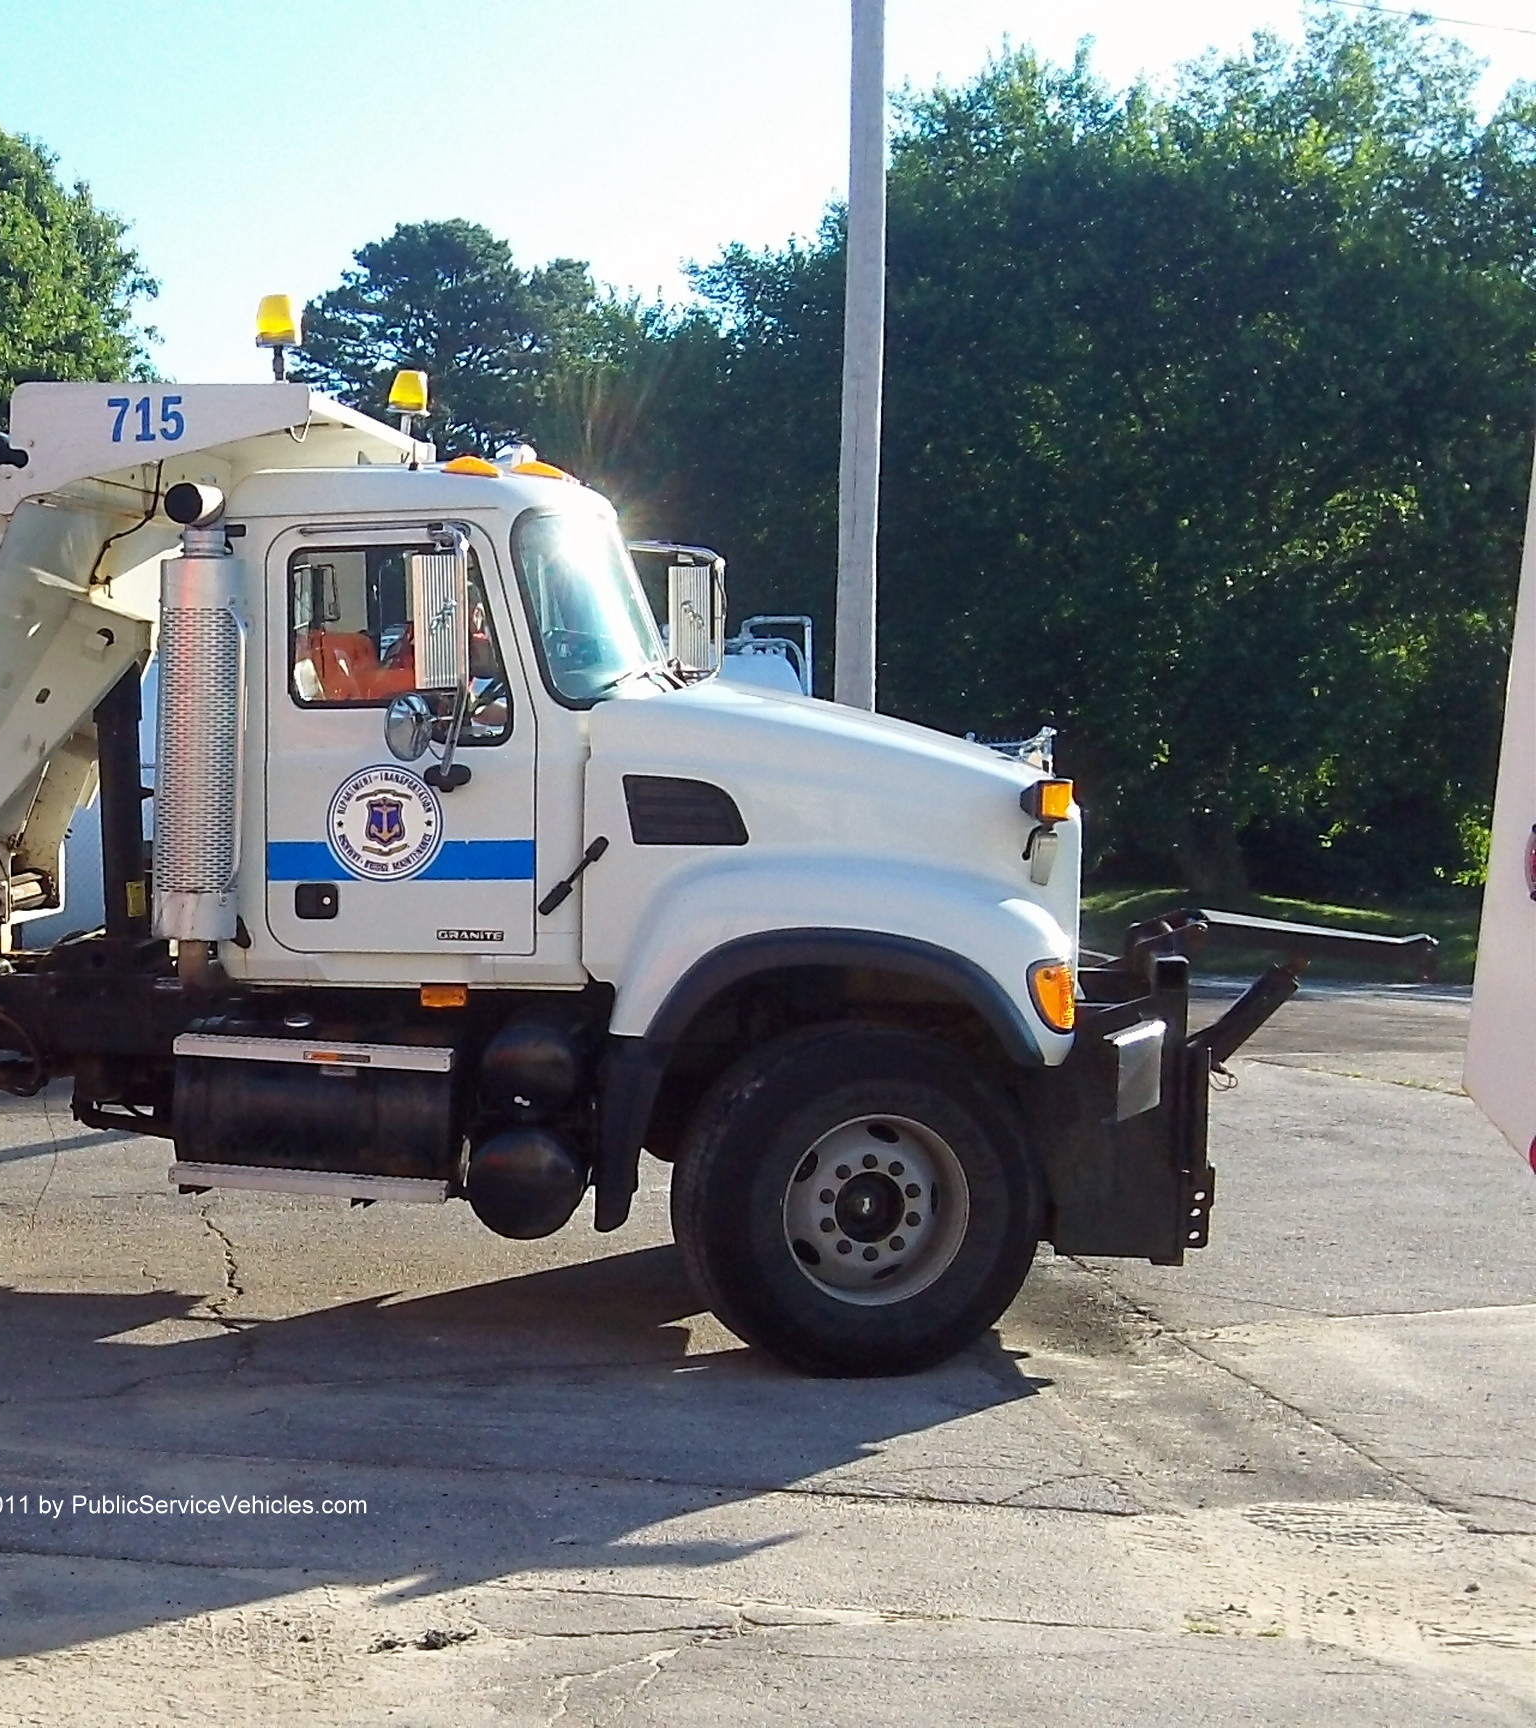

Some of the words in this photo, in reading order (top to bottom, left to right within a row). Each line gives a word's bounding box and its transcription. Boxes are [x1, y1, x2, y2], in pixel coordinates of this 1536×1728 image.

[107, 395, 185, 442] 715
[336, 774, 373, 815] DEPARTMENT
[380, 772, 434, 814] TRANSPORTATION
